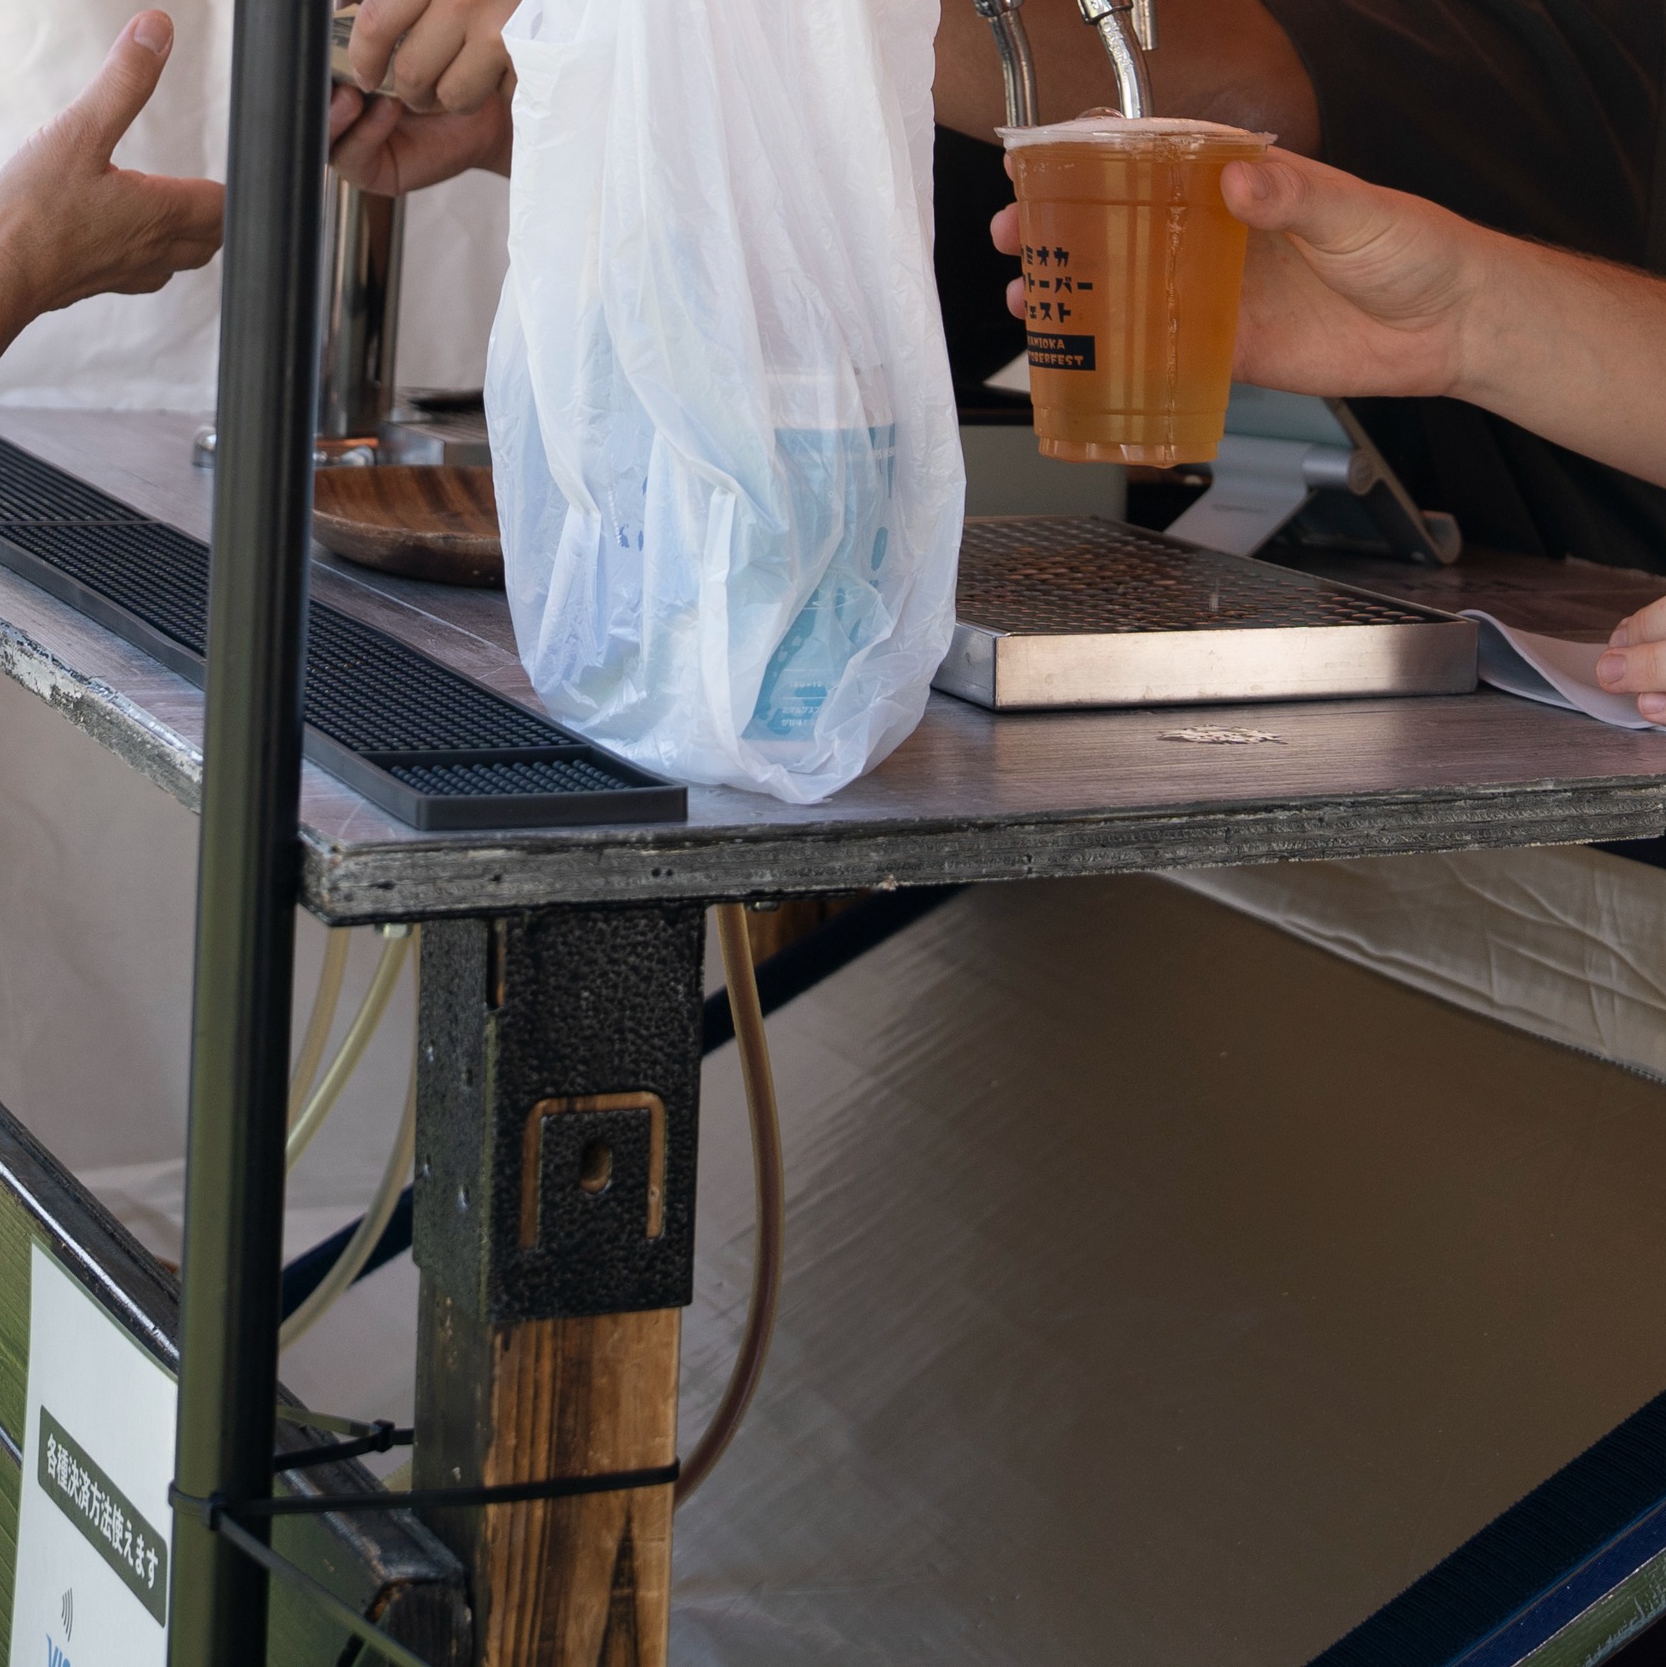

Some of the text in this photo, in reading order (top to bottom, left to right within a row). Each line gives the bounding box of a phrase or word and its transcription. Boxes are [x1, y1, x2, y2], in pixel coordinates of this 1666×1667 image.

[1020, 245, 1070, 268] ミオカ
[1023, 272, 1094, 294] トーバー
[46, 1432, 159, 1590] 各種決済方法使えます
